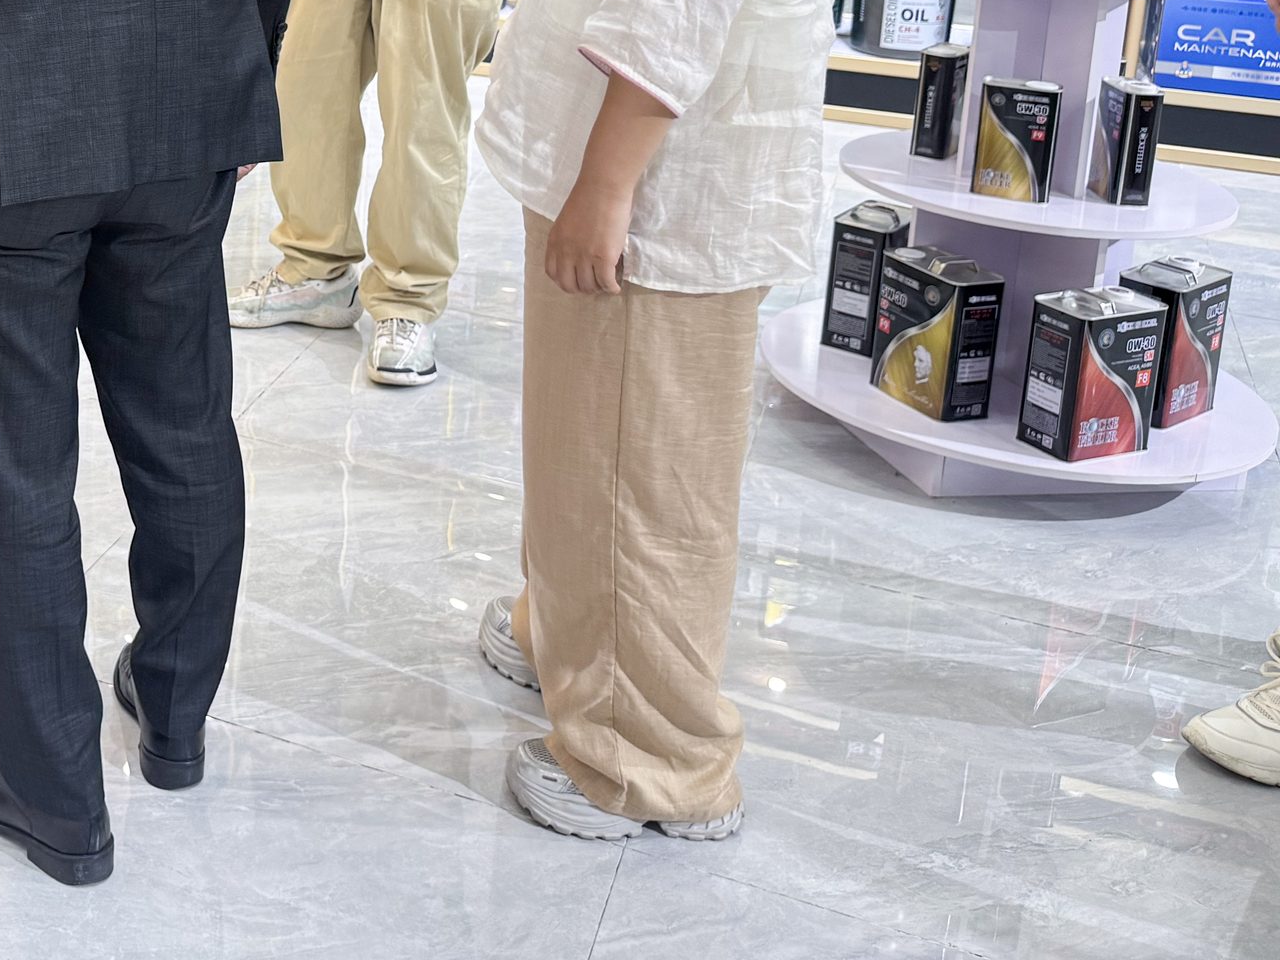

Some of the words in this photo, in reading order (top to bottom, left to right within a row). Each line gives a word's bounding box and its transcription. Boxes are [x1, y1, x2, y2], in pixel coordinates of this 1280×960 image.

[901, 8, 928, 22] OIL
[883, 11, 897, 44] DIESEL
[1177, 24, 1255, 47] CAR
[1174, 41, 1280, 62] MAINTENAN
[1126, 335, 1157, 353] 0W-30
